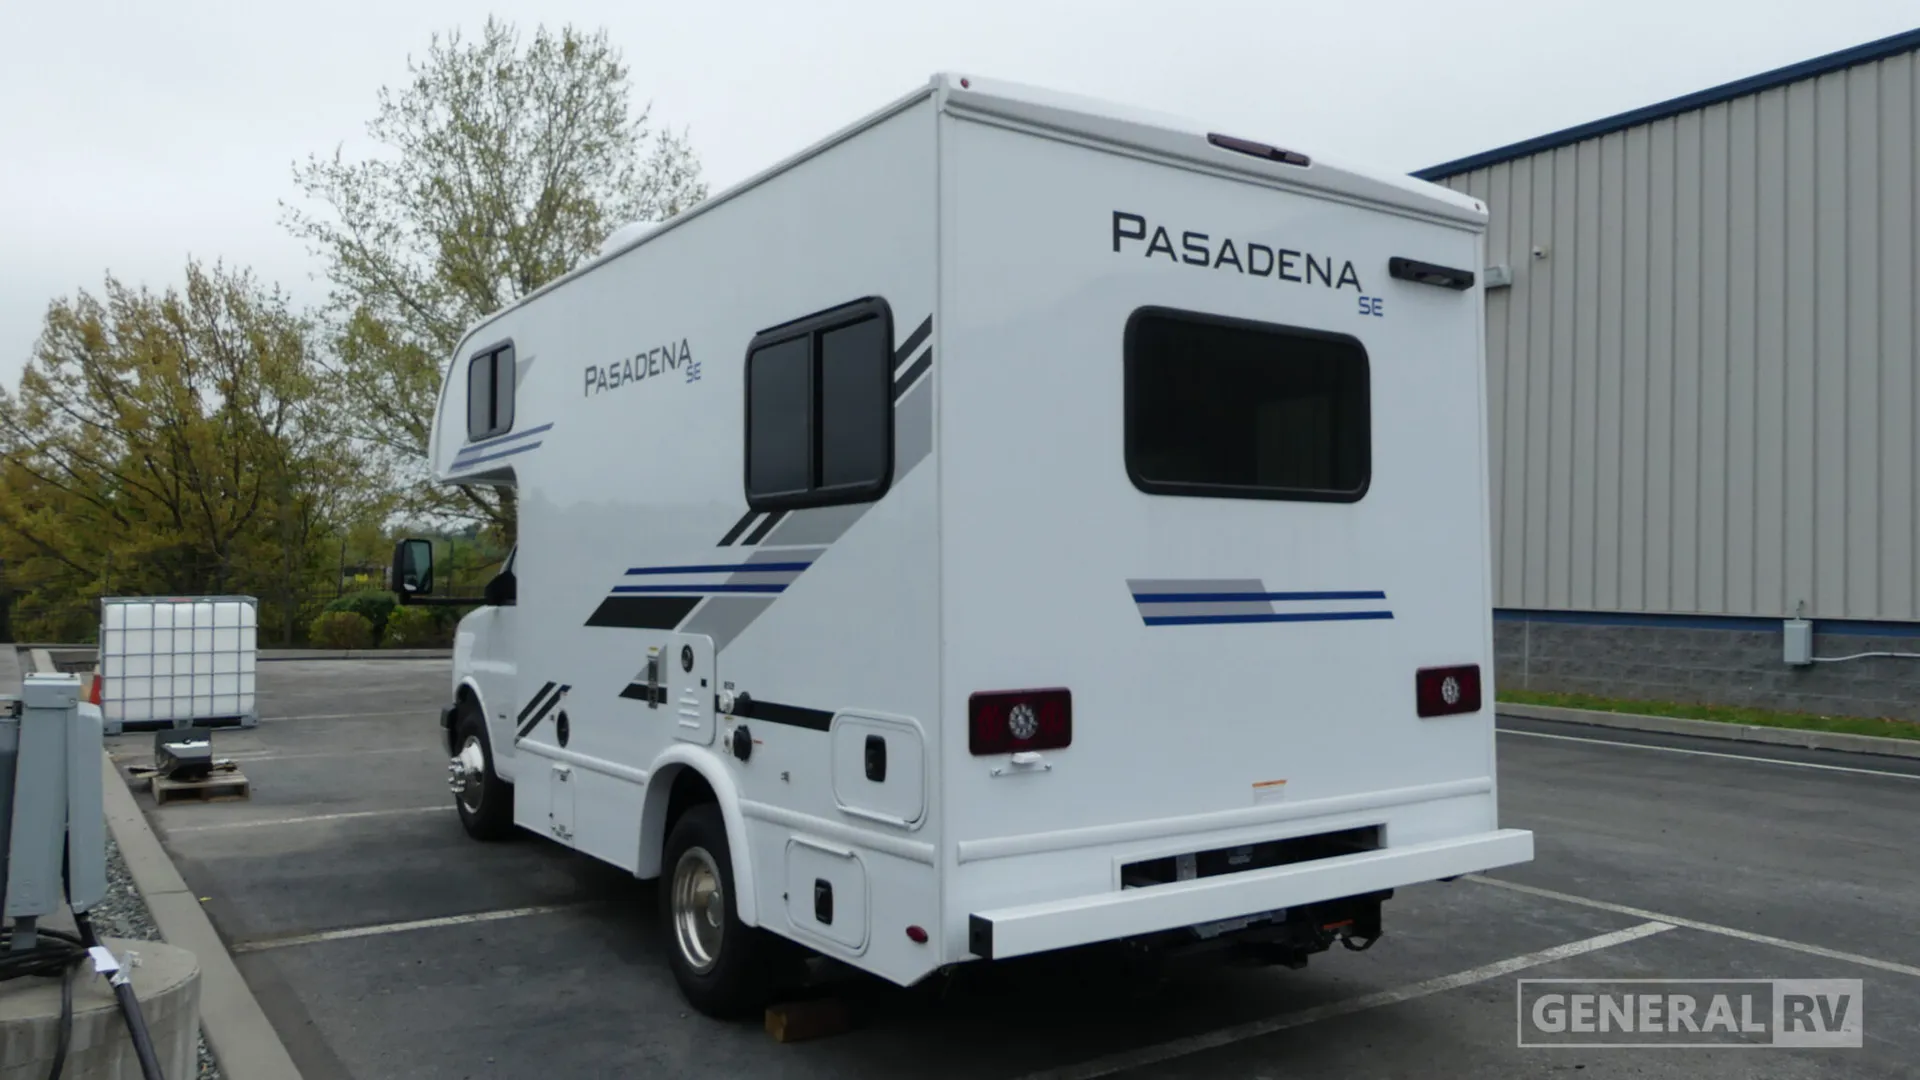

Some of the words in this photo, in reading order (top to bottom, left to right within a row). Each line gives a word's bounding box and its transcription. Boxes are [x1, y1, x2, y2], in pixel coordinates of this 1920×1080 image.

[1112, 210, 1363, 293] PASADENA
[1358, 296, 1384, 317] SE
[584, 337, 693, 398] PASADENA
[685, 361, 702, 384] SE
